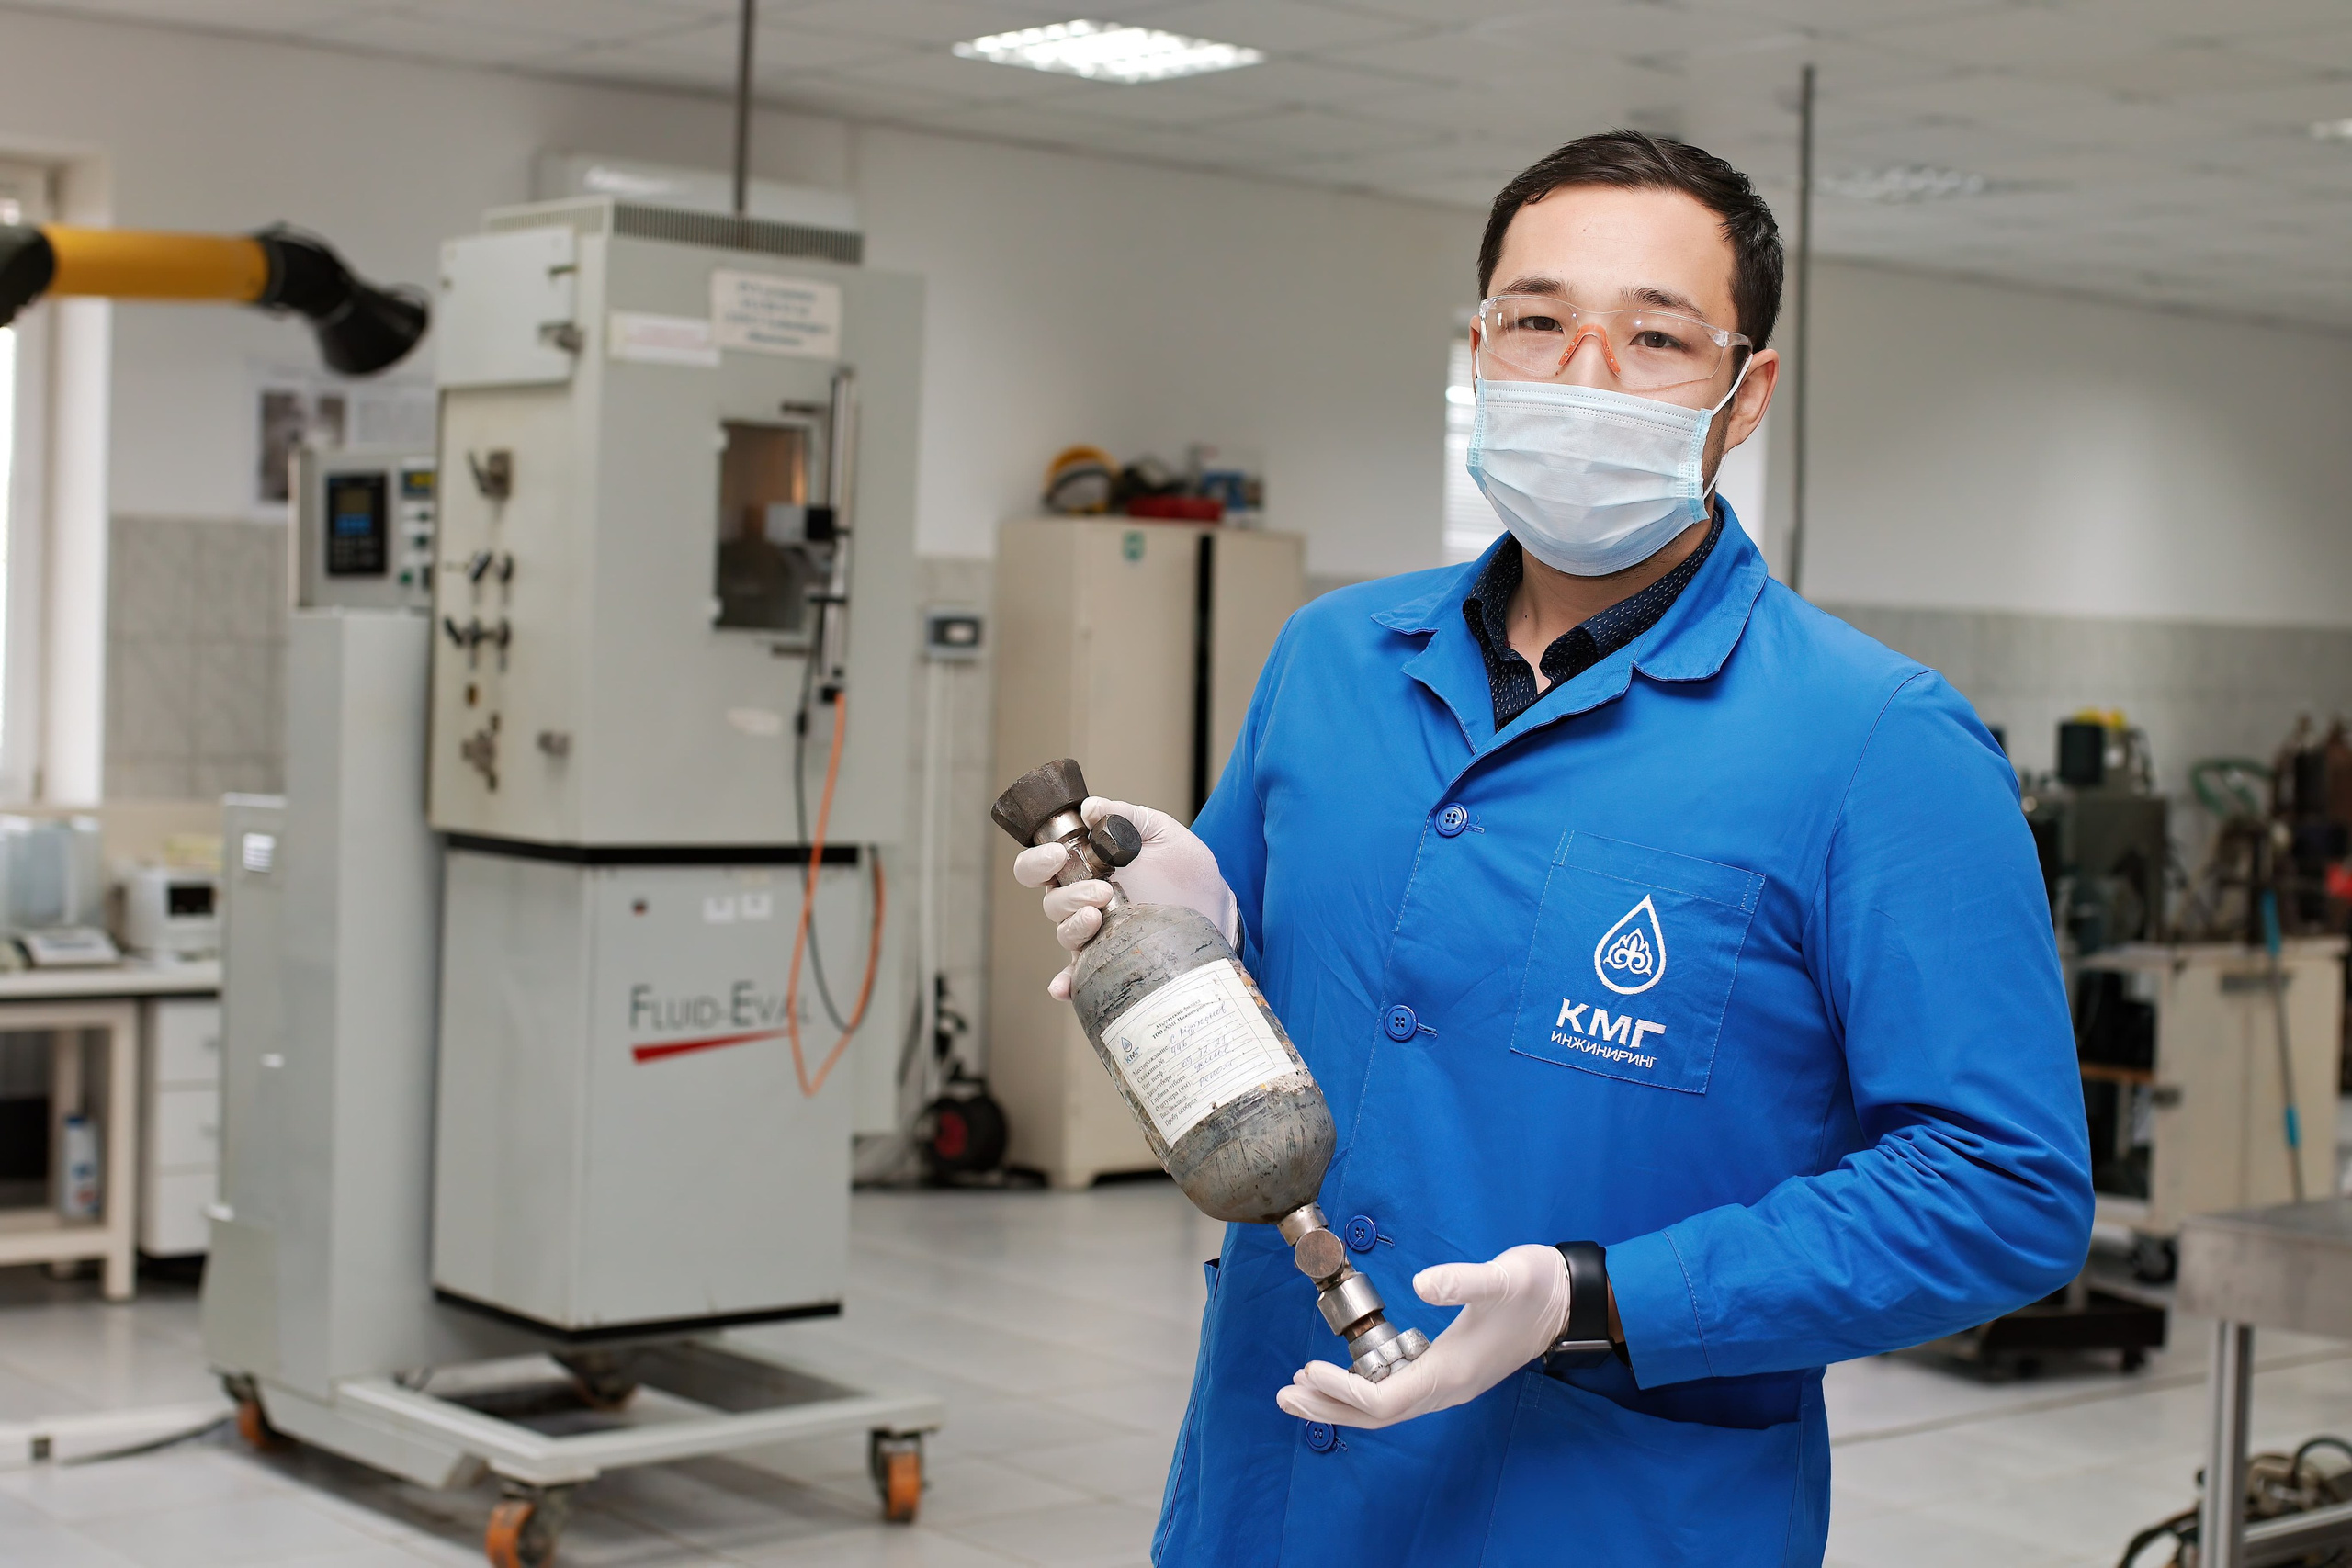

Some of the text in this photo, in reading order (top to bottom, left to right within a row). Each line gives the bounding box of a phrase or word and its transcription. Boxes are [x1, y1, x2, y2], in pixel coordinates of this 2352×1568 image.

[1555, 997, 1667, 1048] КМГ
[1125, 1047, 1139, 1064] КМГ
[1550, 1030, 1657, 1069] ИНЖИНИРИНГ
